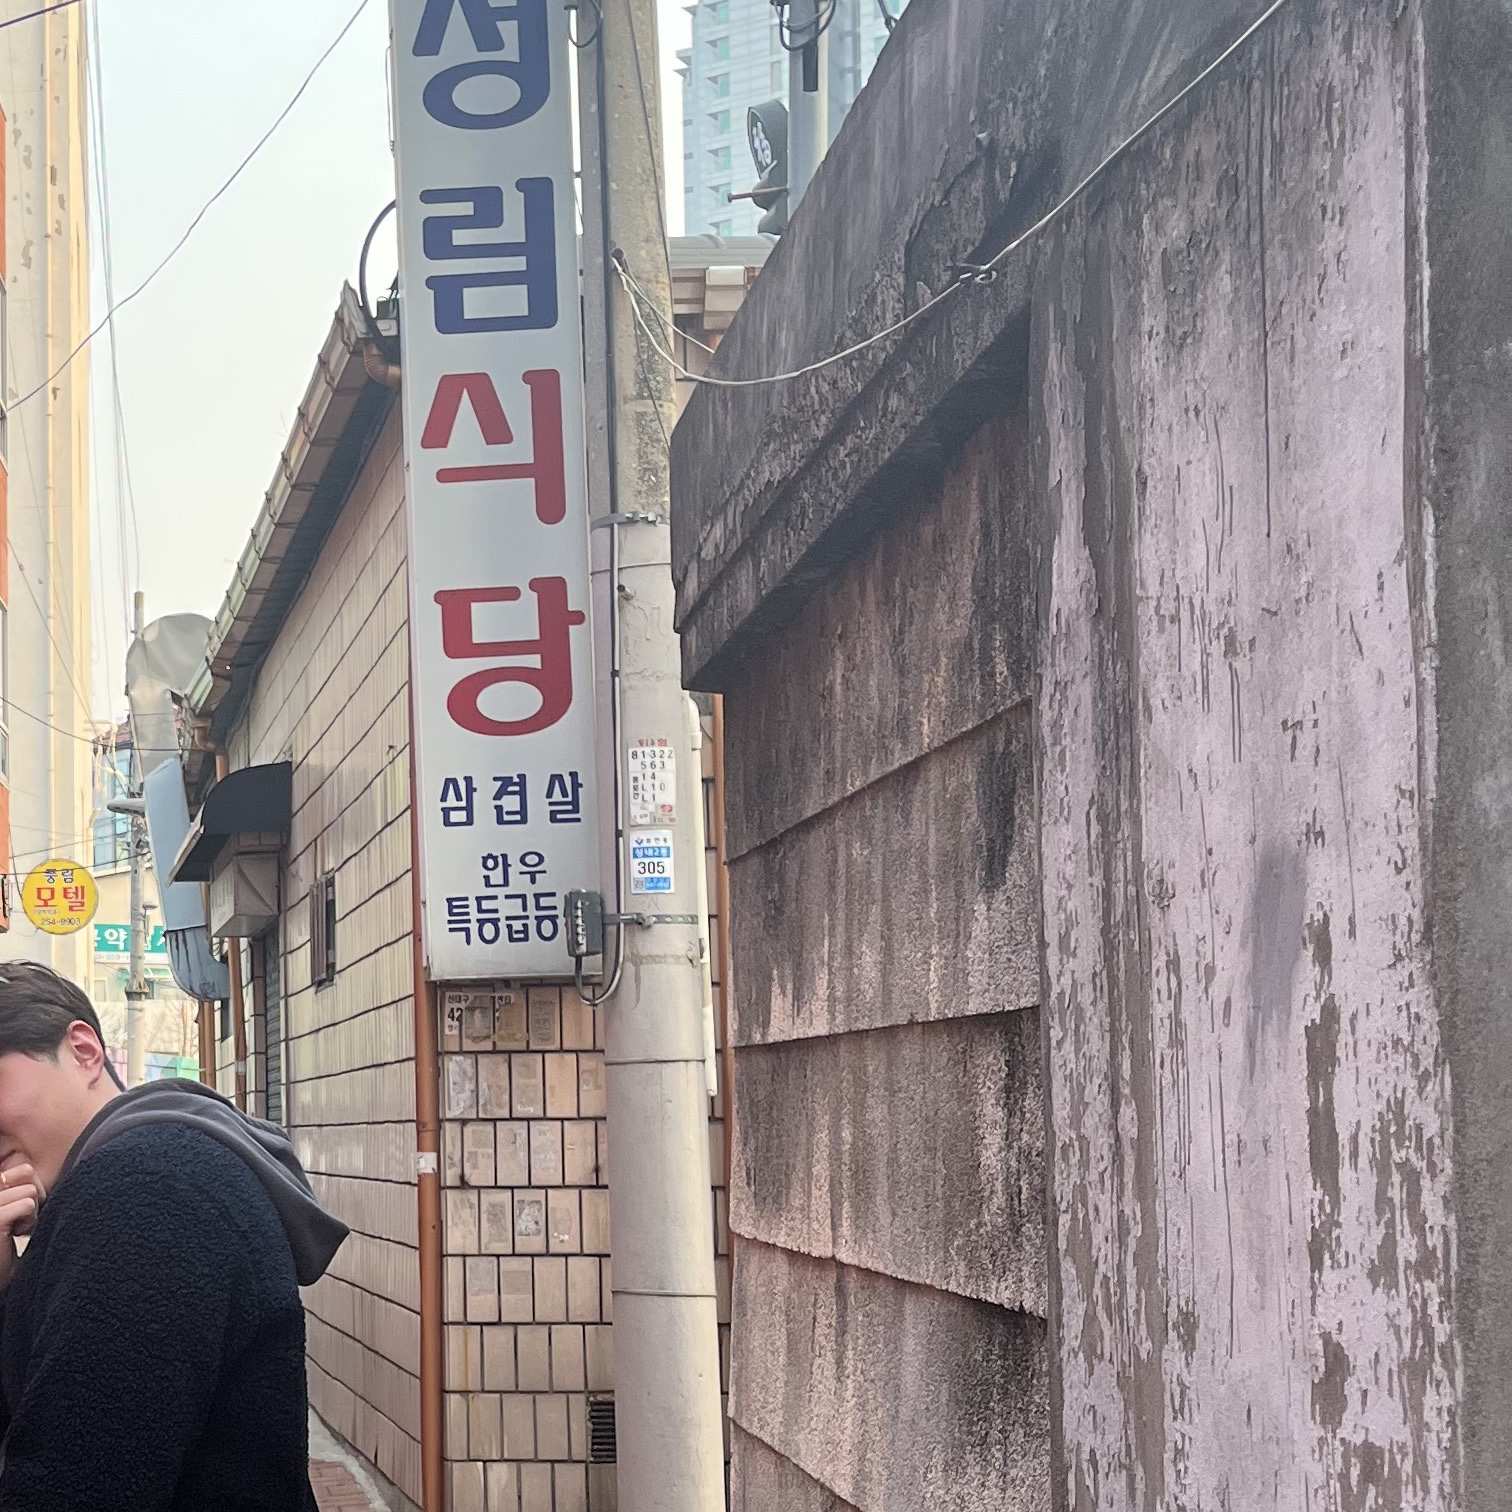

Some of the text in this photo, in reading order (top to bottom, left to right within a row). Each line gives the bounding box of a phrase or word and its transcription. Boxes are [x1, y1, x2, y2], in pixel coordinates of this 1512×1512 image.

[439, 770, 584, 828] 삼겹살
[480, 850, 548, 888] 한우
[637, 861, 665, 875] 305
[34, 885, 86, 912] 모텔
[445, 891, 560, 947] 특등급등
